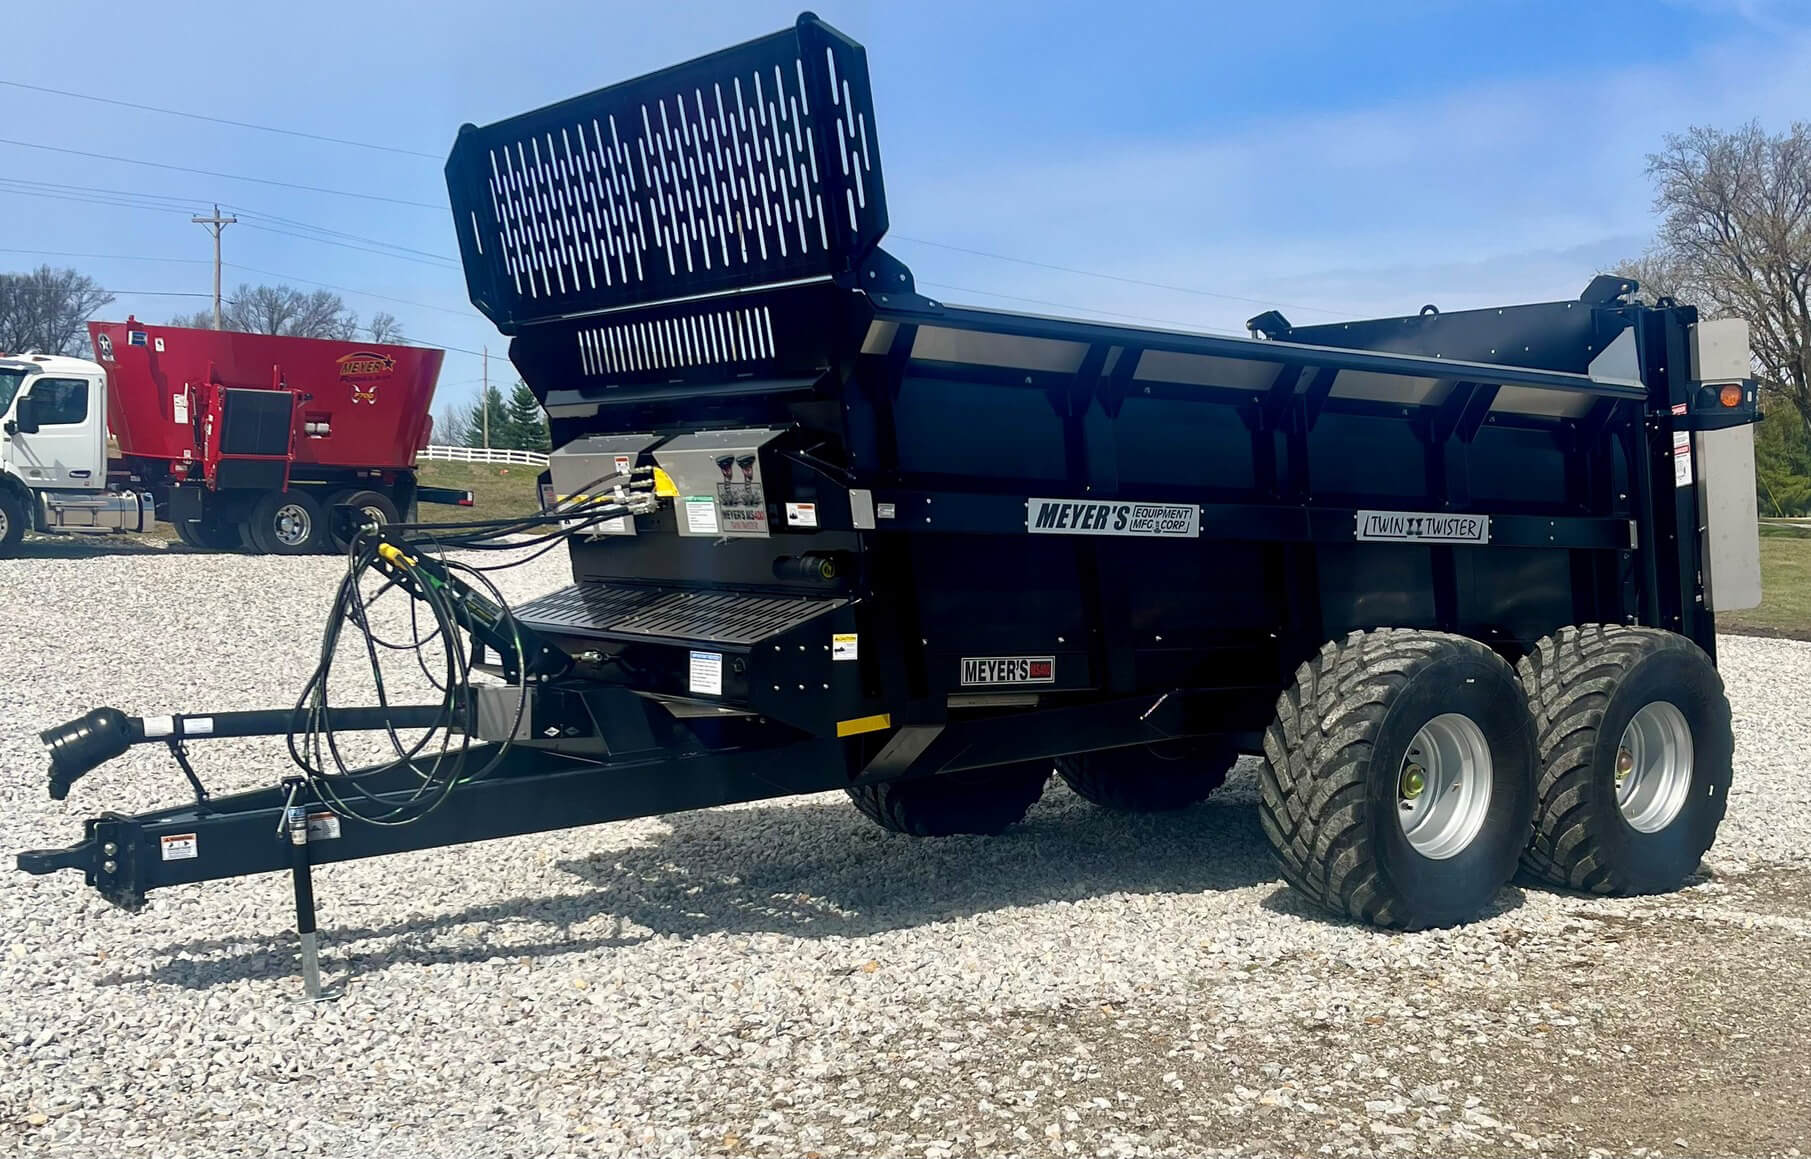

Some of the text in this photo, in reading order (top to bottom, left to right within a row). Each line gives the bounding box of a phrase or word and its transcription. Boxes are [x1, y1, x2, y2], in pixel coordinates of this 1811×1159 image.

[341, 360, 382, 375] MEYER
[1035, 503, 1130, 530] MEYER'S
[1135, 508, 1190, 520] EQUIPMENT
[1371, 515, 1478, 537] TWIN TWISTER
[965, 659, 1028, 682] MEYER'S
